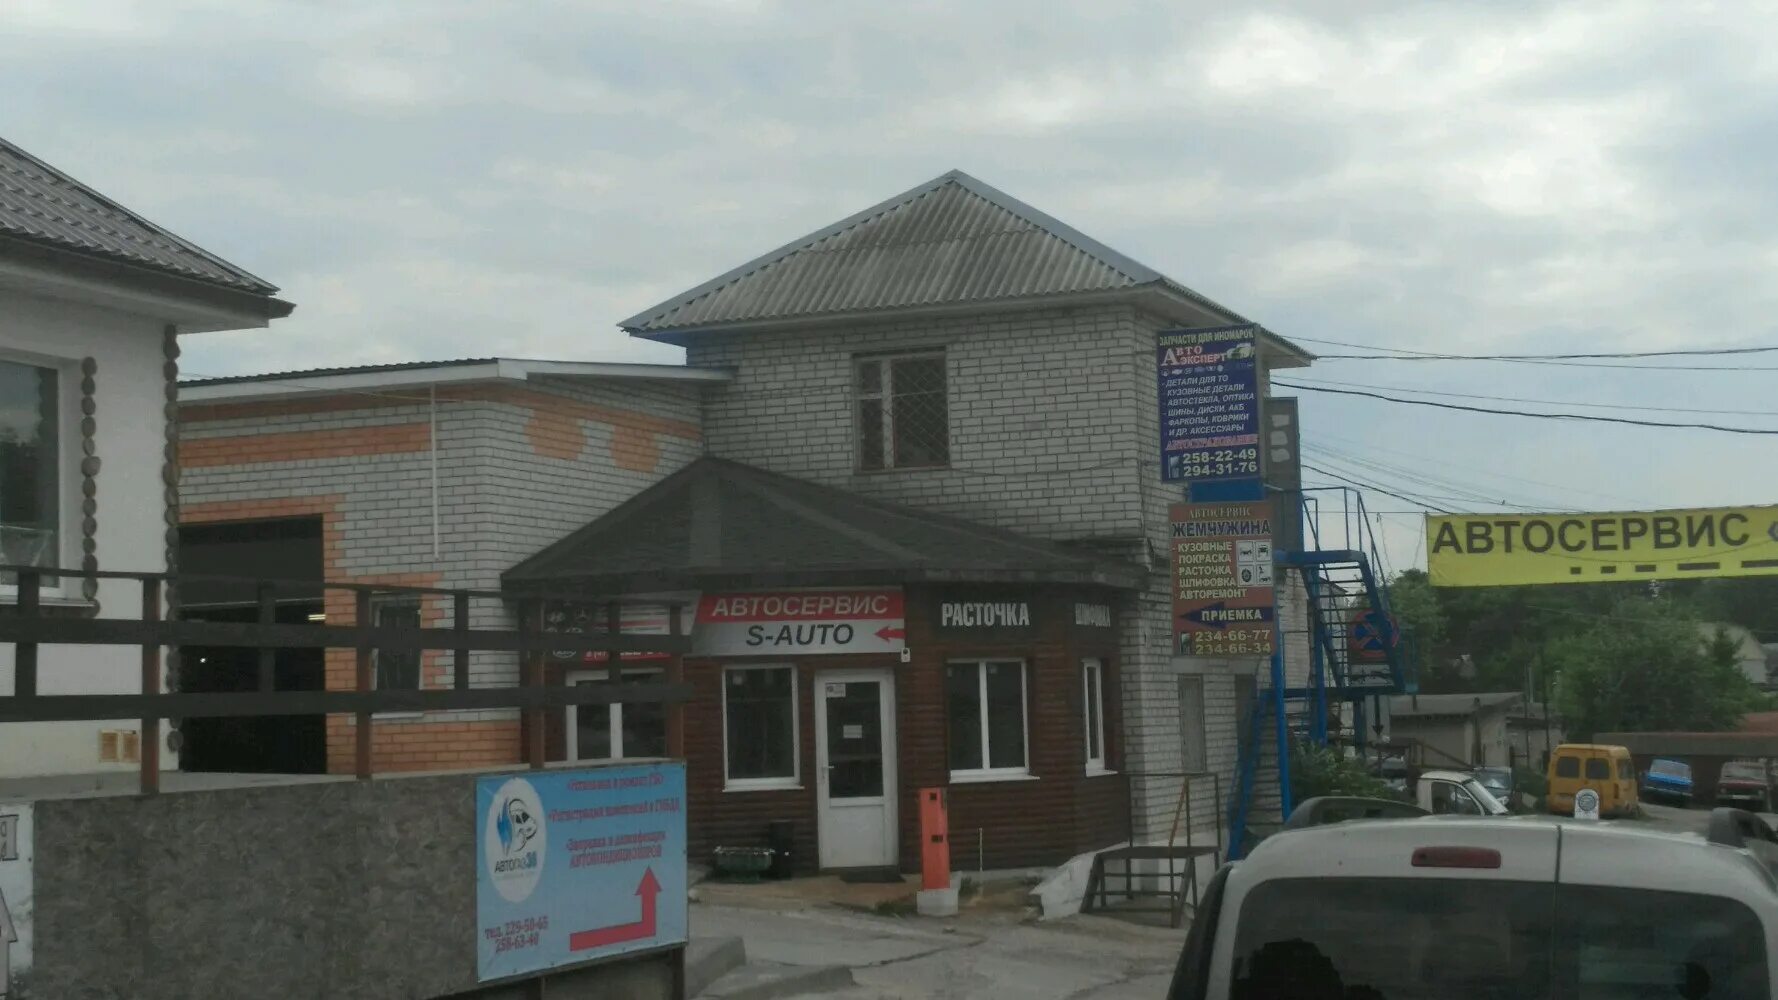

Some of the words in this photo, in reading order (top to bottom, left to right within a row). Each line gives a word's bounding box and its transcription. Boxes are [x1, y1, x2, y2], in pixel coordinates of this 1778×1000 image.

[1160, 334, 1197, 346] ЗАПЧАСТИ
[1198, 332, 1213, 345] ДЛЯ
[1214, 328, 1254, 341] ИНОМАРОК
[1179, 353, 1226, 365] ЭКСПЕРТ
[1166, 377, 1198, 388] ДЕТАЛИ
[1199, 376, 1216, 386] ДЛЯ
[1218, 374, 1229, 383] ТО
[1167, 386, 1211, 397] КУЗОВНЫЕ
[1212, 383, 1245, 395] ДЕТАЛИ
[1222, 392, 1255, 402] ОПТИКА
[1228, 403, 1245, 412] АКБ
[1211, 413, 1249, 423] КОВРИКИ
[1175, 427, 1188, 437] ДР.
[1190, 424, 1244, 435] АКСЕССУАРЫ
[1182, 448, 1256, 464] 258-22-49
[1183, 461, 1257, 477] 294-31-76
[1172, 519, 1271, 537] ЖЕМЧУЖИНА
[1432, 512, 1750, 554] АВТОСЕРВИС
[1178, 541, 1233, 553] КУЗОВНЫЕ
[1178, 554, 1231, 564] ПОКРАСКА
[1178, 566, 1232, 576] РАСТОЧКА
[1180, 577, 1236, 588] ШЛИФОВКА
[1180, 588, 1248, 600] АВТОРЕМОНТ
[711, 595, 888, 617] АВТОСЕРВИС
[941, 602, 1030, 627] РАСТОЧКА
[1201, 609, 1262, 621] ПРИЕМКА
[746, 623, 854, 646] S-AUTO
[1195, 629, 1271, 642] 234-66-77
[1196, 642, 1272, 655] 234-66-34
